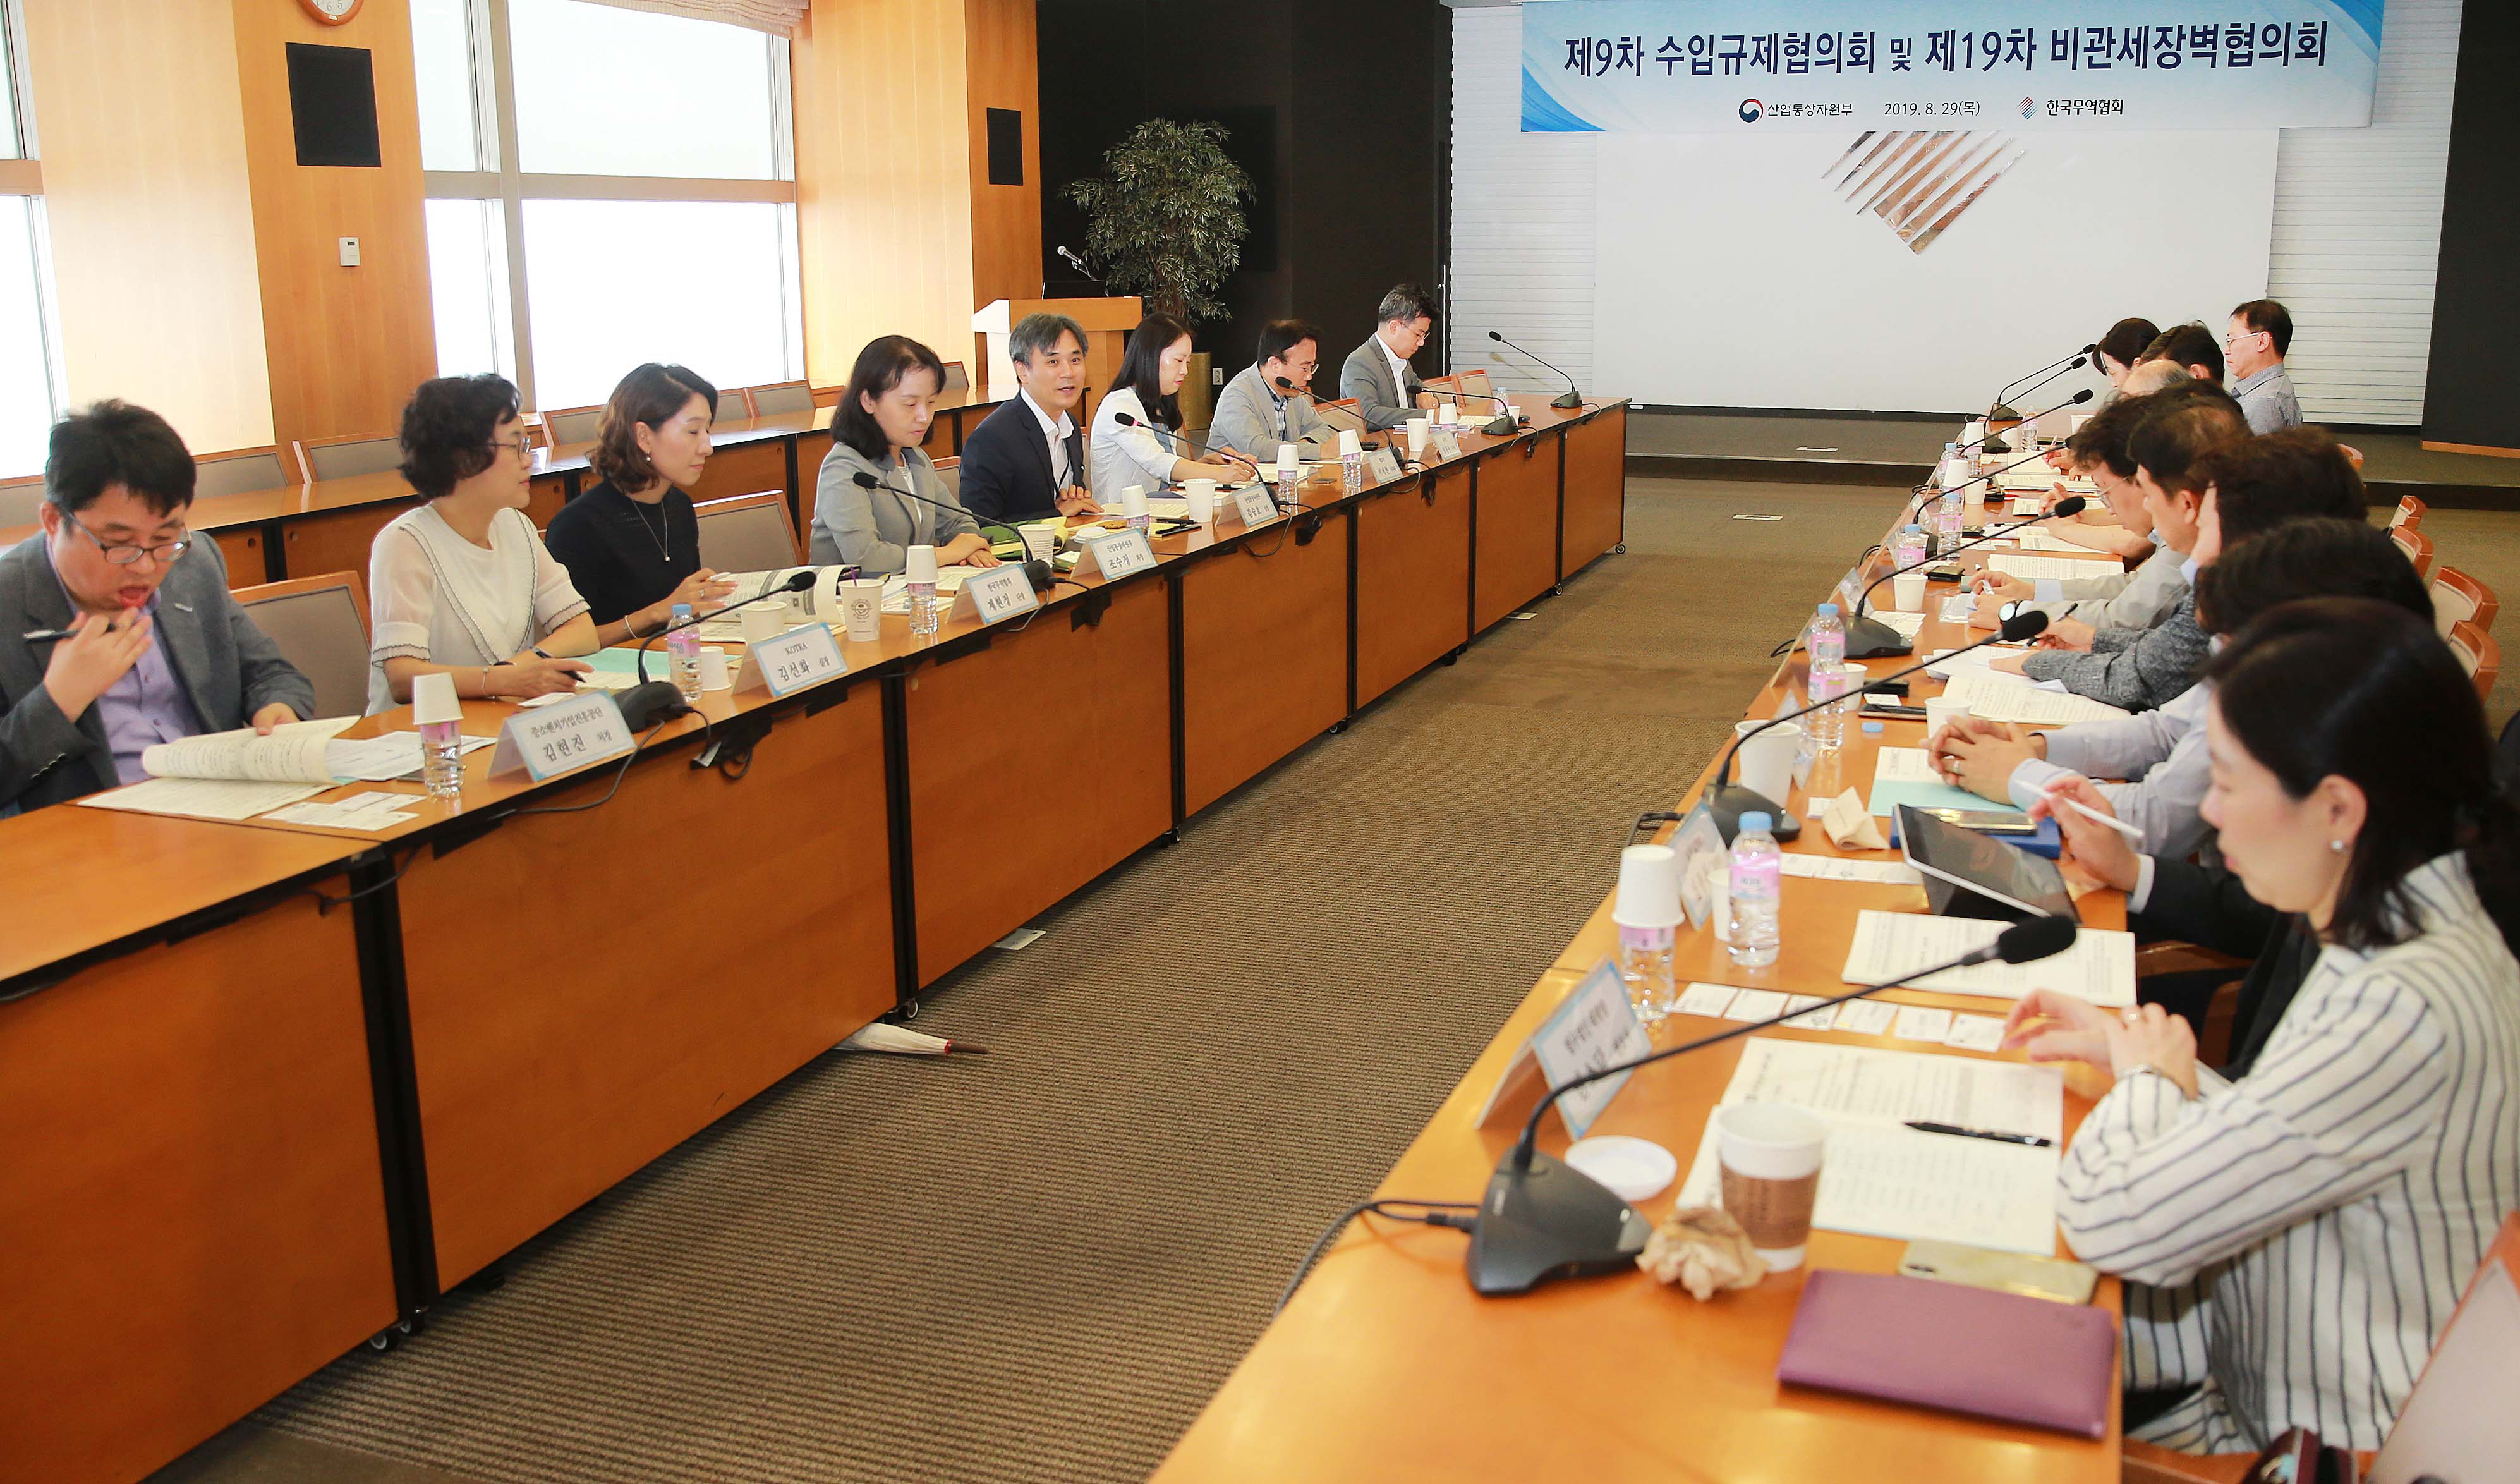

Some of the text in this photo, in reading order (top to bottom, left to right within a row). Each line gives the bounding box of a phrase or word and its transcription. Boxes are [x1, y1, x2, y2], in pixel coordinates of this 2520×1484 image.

[1564, 21, 2329, 77] 제9차 수입규제협의회 및 제19차 비관세장벽협의회
[1767, 103, 1853, 117] 산업통상자원부
[1884, 100, 1980, 116] 2019. 8. 29(목)
[2047, 99, 2124, 116] 한국무역협회
[785, 642, 808, 655] KOTRA
[778, 659, 810, 682] 김선화
[543, 733, 587, 762] 김현진
